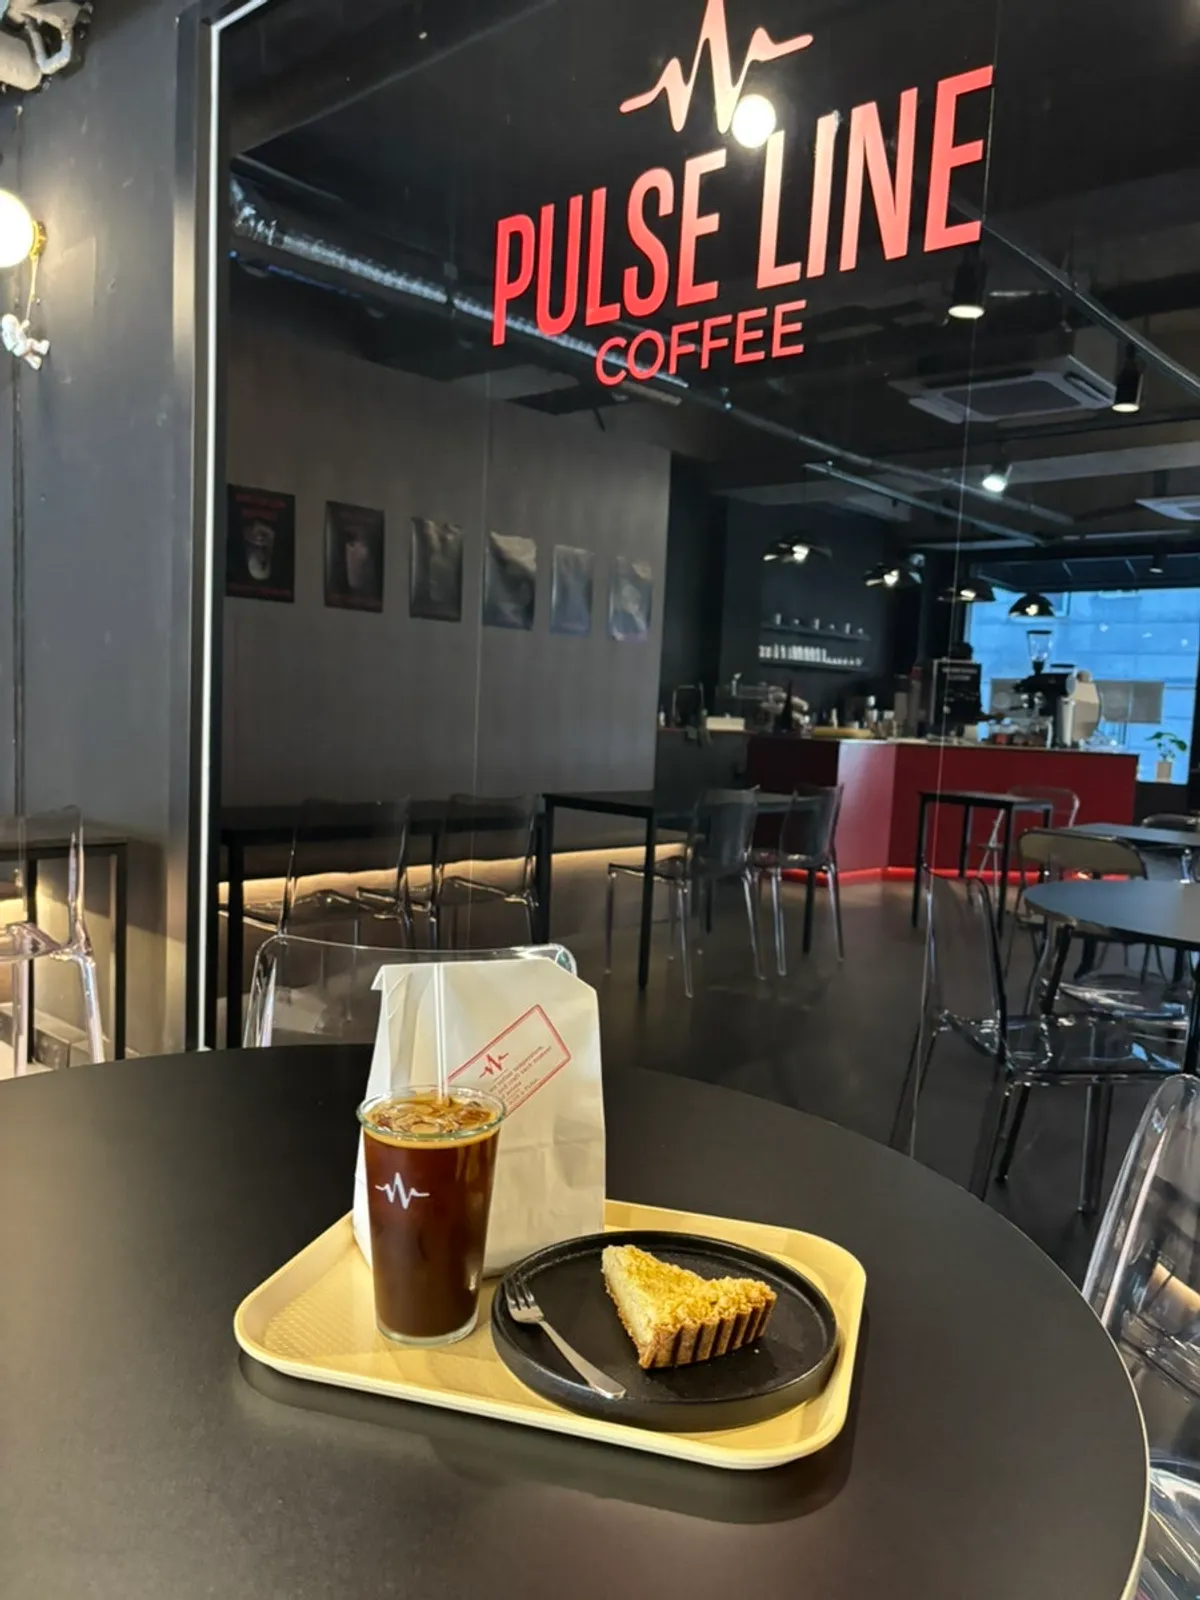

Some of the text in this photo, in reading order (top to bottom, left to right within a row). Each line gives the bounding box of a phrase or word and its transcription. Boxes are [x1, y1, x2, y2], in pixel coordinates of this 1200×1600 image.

[492, 65, 993, 346] PULSE LINE
[595, 300, 806, 386] COFFEE
